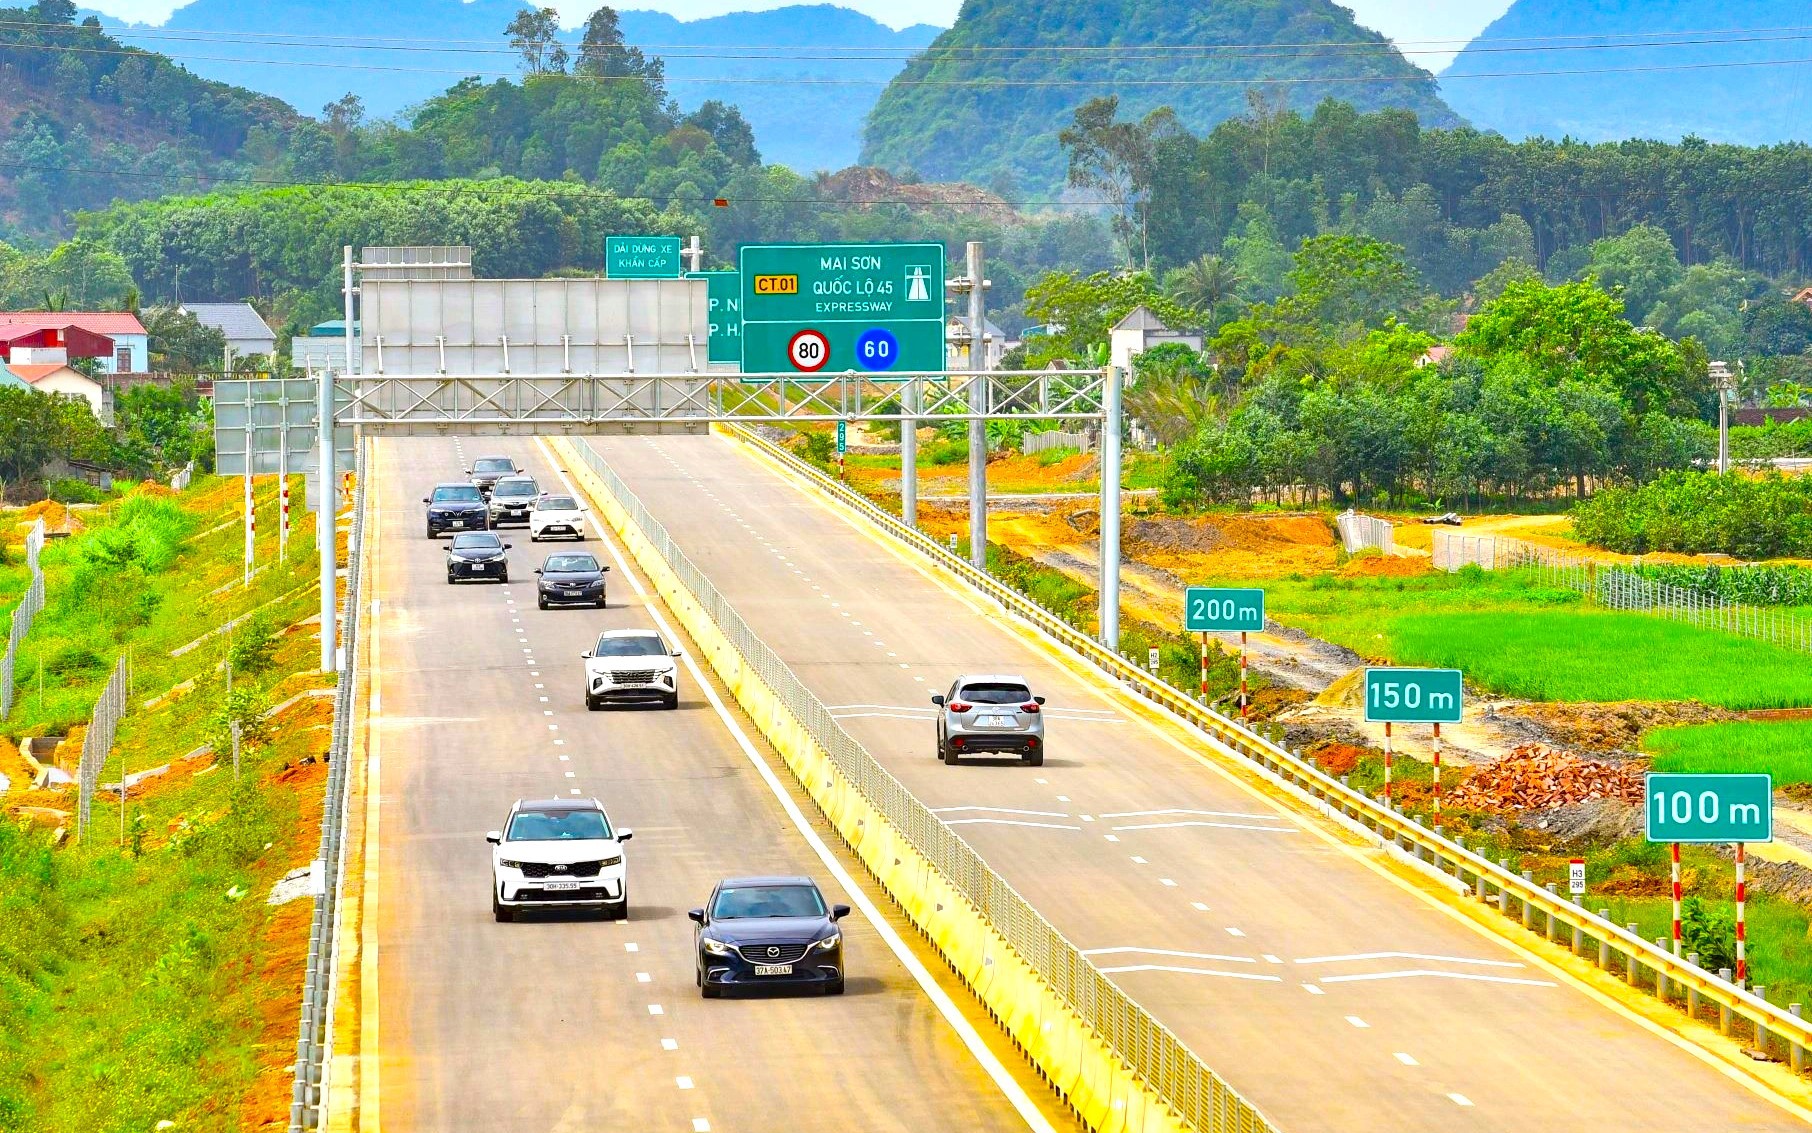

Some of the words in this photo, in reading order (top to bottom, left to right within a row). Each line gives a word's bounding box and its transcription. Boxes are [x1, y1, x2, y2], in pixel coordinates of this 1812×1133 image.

[661, 245, 672, 254] XE
[648, 256, 667, 267] CẤP
[820, 256, 847, 270] MAI
[851, 255, 881, 270] SƠN
[758, 278, 795, 292] CT.01
[813, 275, 852, 295] QUỐC
[856, 278, 874, 297] LỘ
[877, 281, 893, 295] 45
[815, 302, 893, 312] EXPRESSWAY
[799, 342, 819, 359] 80
[864, 340, 889, 358] 60
[1192, 598, 1235, 620] 200
[1239, 607, 1257, 621] m
[1370, 682, 1421, 709] 150
[1429, 692, 1454, 709] m
[1653, 790, 1720, 824] 100
[1729, 803, 1760, 824] m
[1572, 869, 1583, 877] H3
